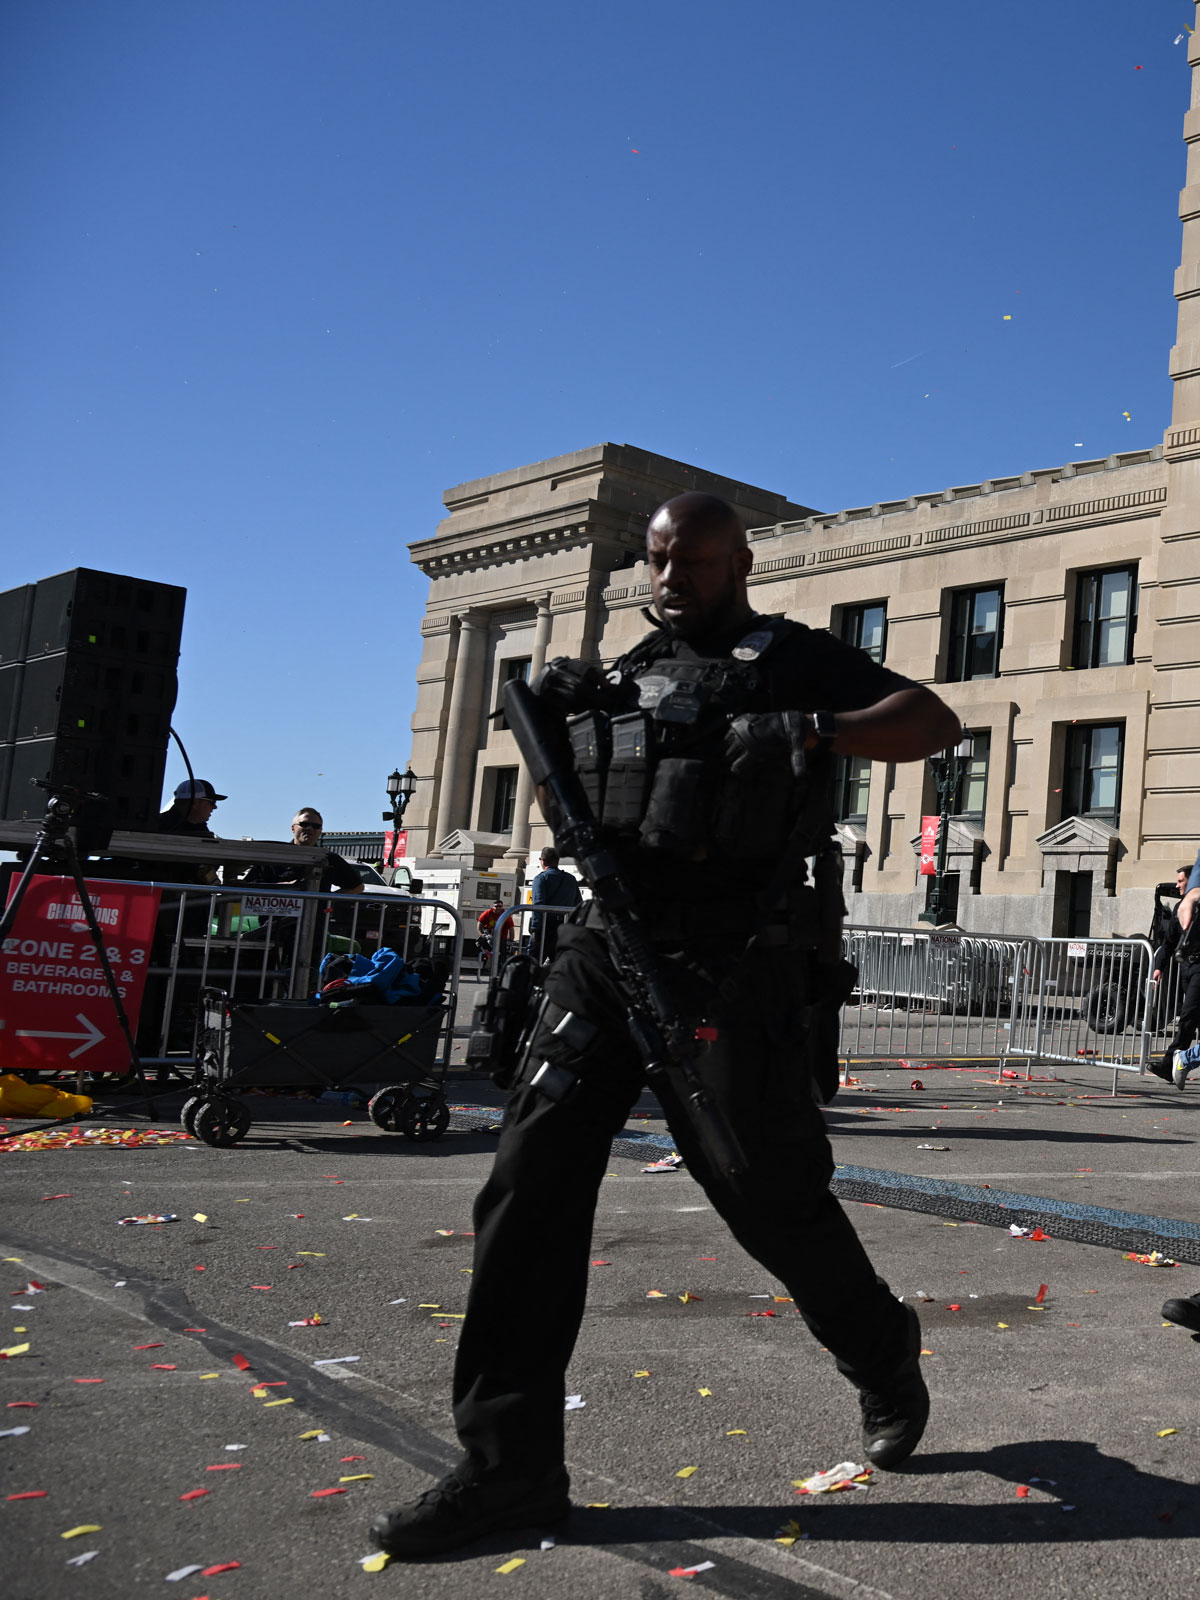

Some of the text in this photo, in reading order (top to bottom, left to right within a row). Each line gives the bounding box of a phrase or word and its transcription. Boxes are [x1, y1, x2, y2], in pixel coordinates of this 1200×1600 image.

[246, 896, 301, 909] NATIONAL
[46, 902, 119, 926] CHAMONS
[930, 935, 961, 945] NATIONAL
[2, 937, 146, 965] ZONE 2 & 3
[120, 970, 134, 983] &
[12, 979, 128, 999] BATHROOMS
